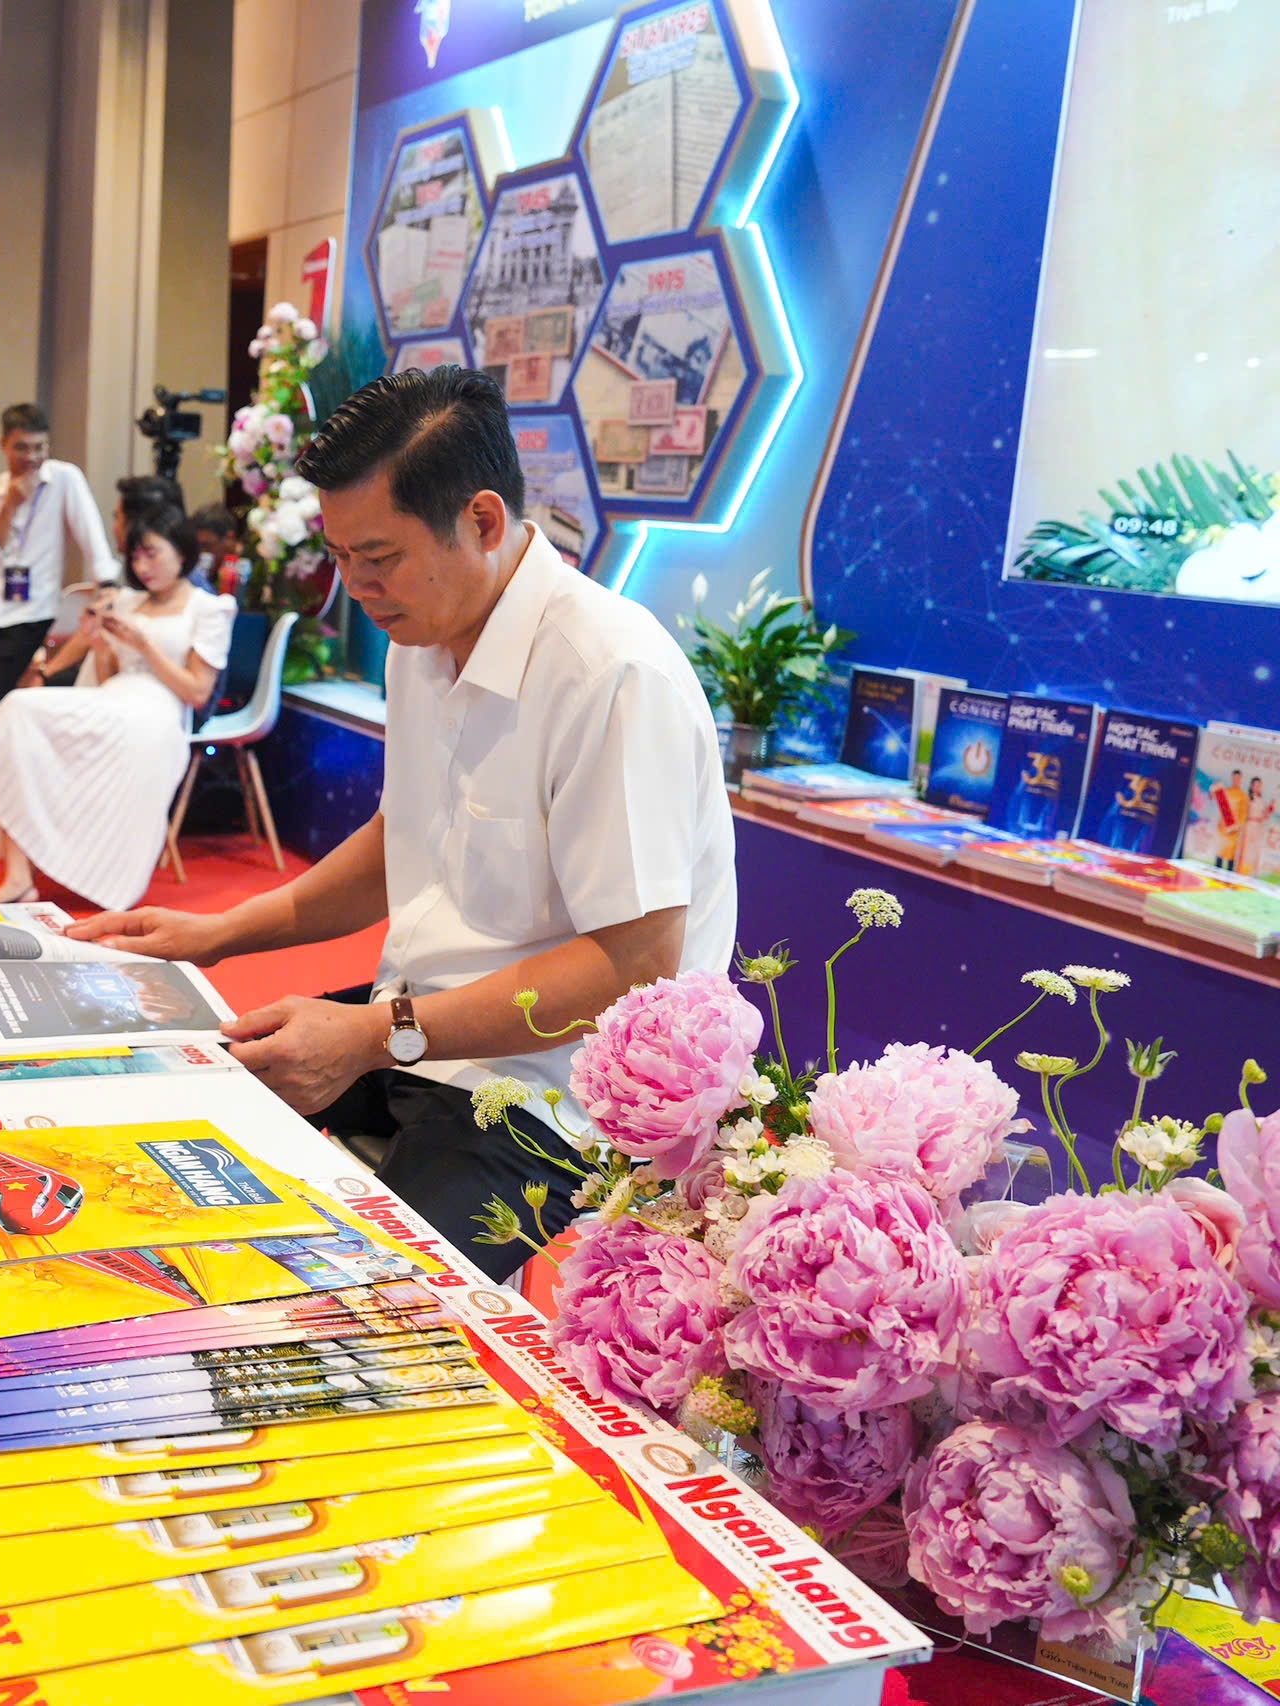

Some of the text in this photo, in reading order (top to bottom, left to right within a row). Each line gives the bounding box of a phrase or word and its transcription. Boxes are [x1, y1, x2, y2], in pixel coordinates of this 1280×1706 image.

[1114, 516, 1177, 536] 09:48
[150, 1141, 240, 1205] NGÂN HÀNG
[664, 1475, 785, 1558] Ngân
[771, 1557, 889, 1648] hàng
